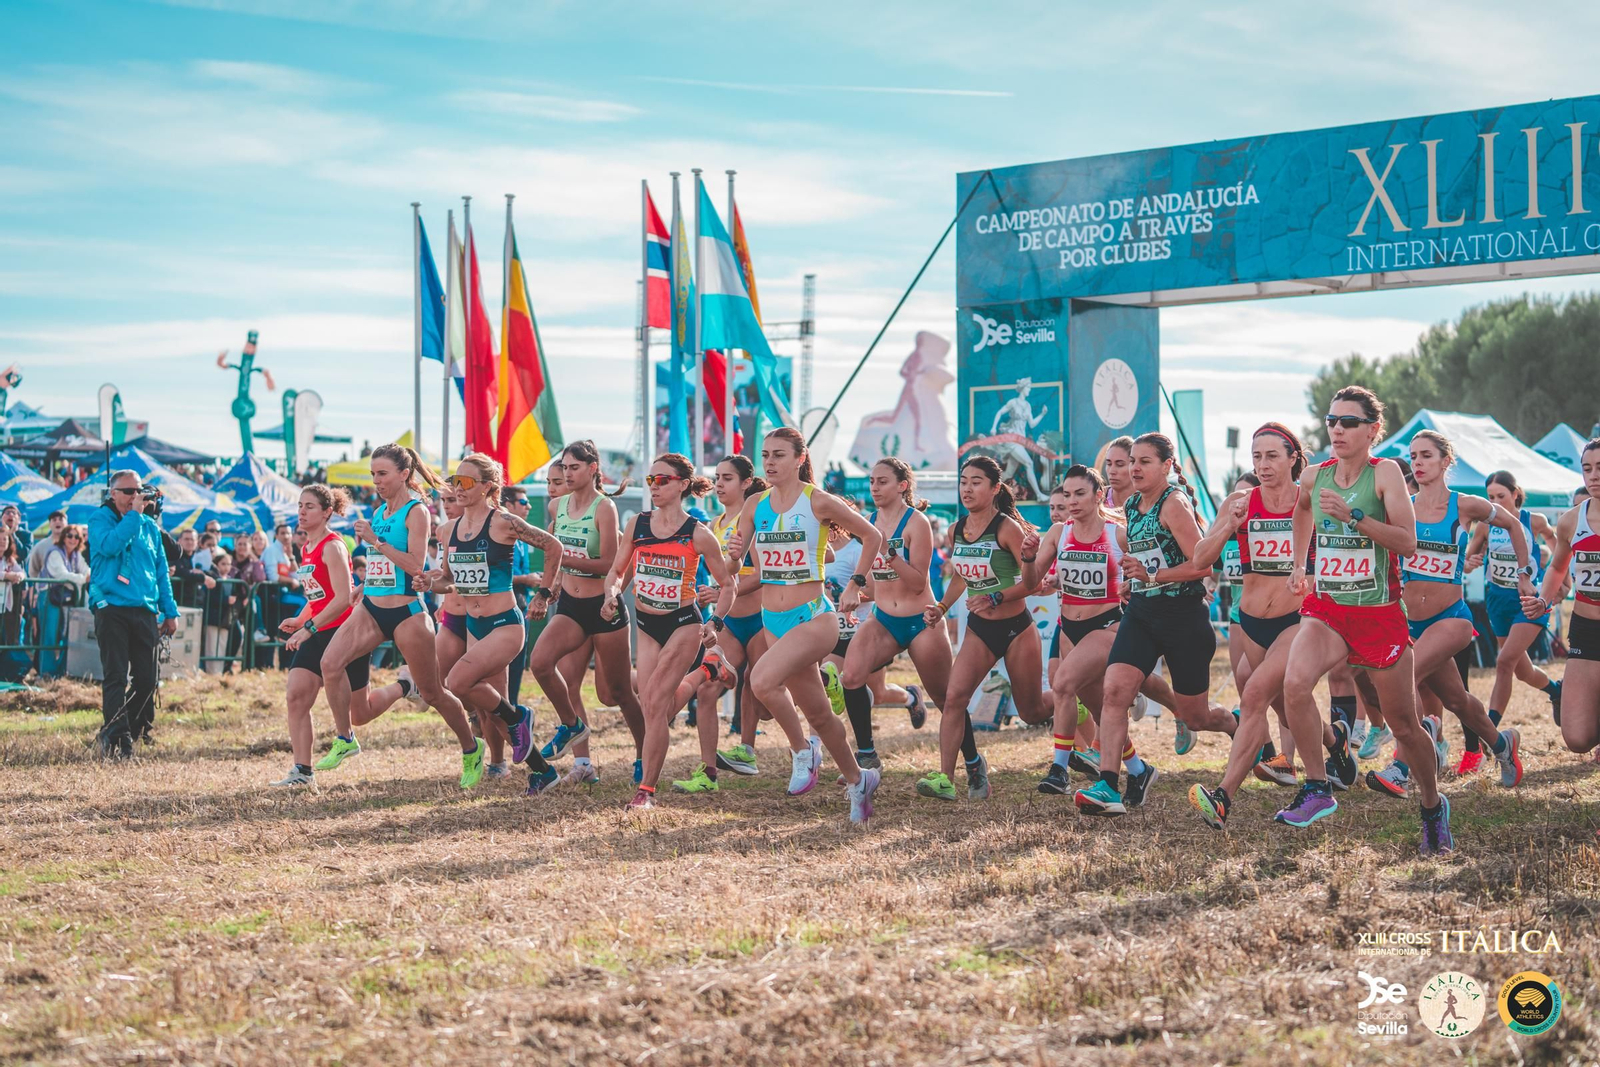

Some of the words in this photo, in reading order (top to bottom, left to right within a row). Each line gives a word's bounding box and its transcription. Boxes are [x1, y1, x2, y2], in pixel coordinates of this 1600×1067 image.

[1347, 122, 1592, 237] XLIII
[976, 202, 1105, 234] CAMPEONATO
[1108, 198, 1134, 219] DE
[1138, 181, 1260, 216] ANDALUCÍA
[1018, 232, 1042, 252] DE
[1045, 223, 1115, 249] CAMPO
[1118, 224, 1134, 242] A
[1138, 209, 1213, 239] TRAVÉS
[1059, 249, 1098, 269] POR
[1101, 240, 1171, 265] CLUBES
[1347, 226, 1576, 272] INTERNATIONAL
[1015, 329, 1056, 344] Sevilla
[1254, 539, 1293, 557] 224
[762, 549, 807, 567] 2242
[1320, 556, 1370, 577] 2244
[1407, 553, 1453, 575] 2252
[455, 569, 487, 584] 2232
[956, 562, 988, 578] 2247
[1061, 567, 1104, 586] 2200
[1493, 564, 1520, 579] 222
[638, 580, 678, 599] 2248
